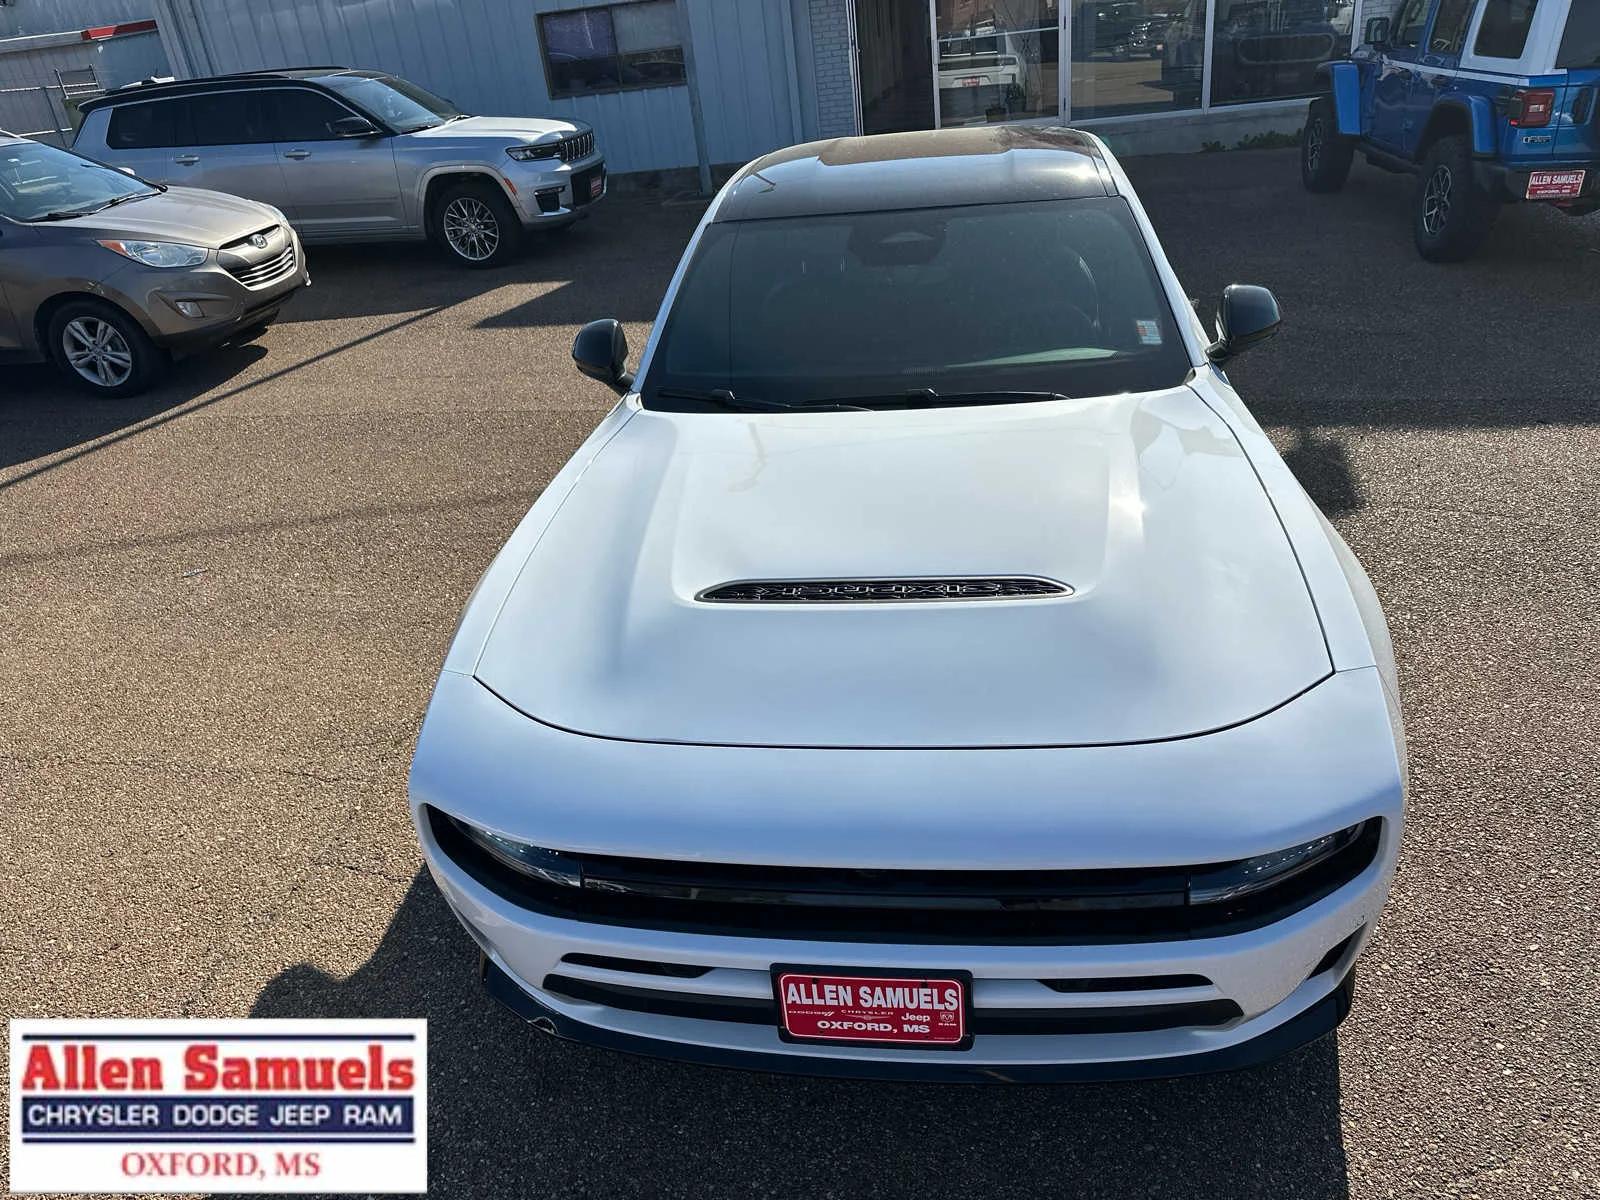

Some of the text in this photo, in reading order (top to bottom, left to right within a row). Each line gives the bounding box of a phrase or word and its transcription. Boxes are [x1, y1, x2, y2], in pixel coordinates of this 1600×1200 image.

[1531, 174, 1582, 184] ALLEN SAMUELS
[787, 983, 958, 1010] ALLEN SAMUELS
[901, 1012, 931, 1023] Jeep
[817, 1020, 930, 1034] OXFORD, MS
